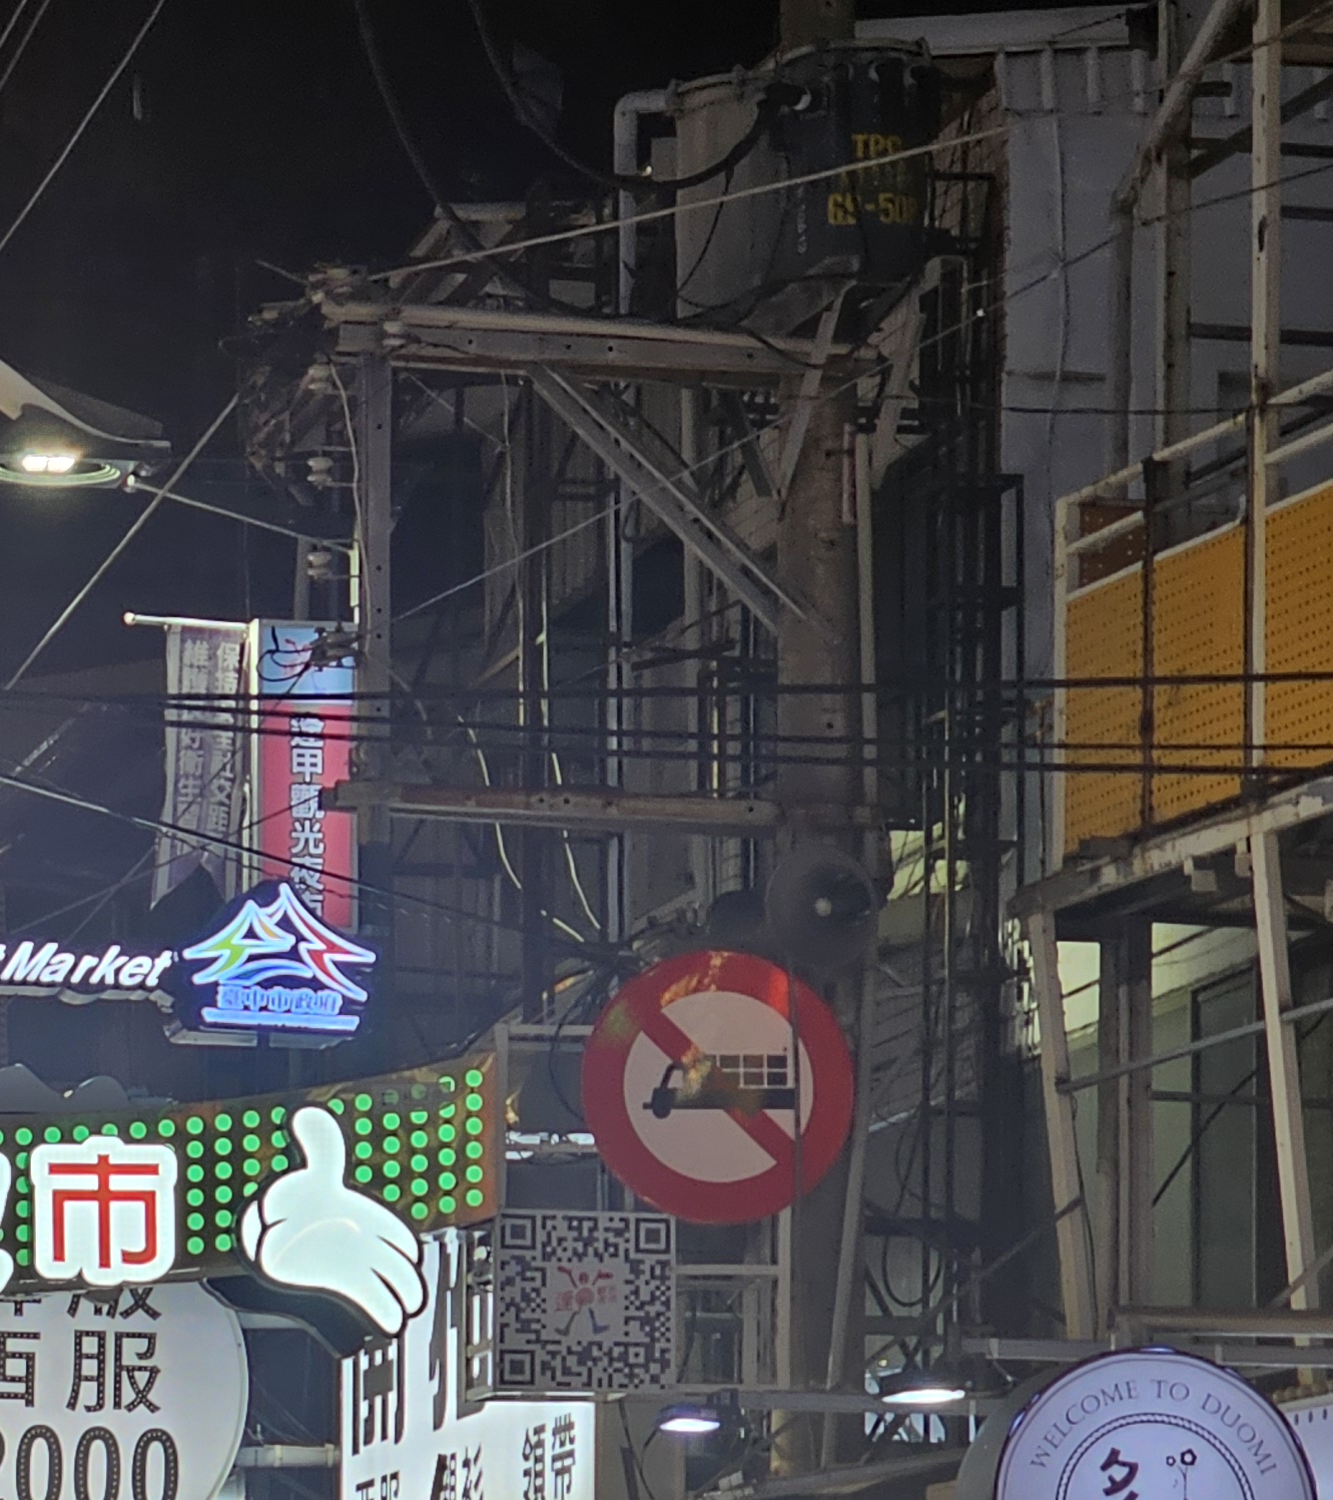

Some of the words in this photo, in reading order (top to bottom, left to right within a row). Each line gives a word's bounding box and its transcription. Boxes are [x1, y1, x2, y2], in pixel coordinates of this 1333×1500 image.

[0, 941, 172, 987] Market
[1030, 1379, 1139, 1471] WELCOME
[1150, 1379, 1191, 1402] TO
[1200, 1393, 1278, 1476] DUOMI
